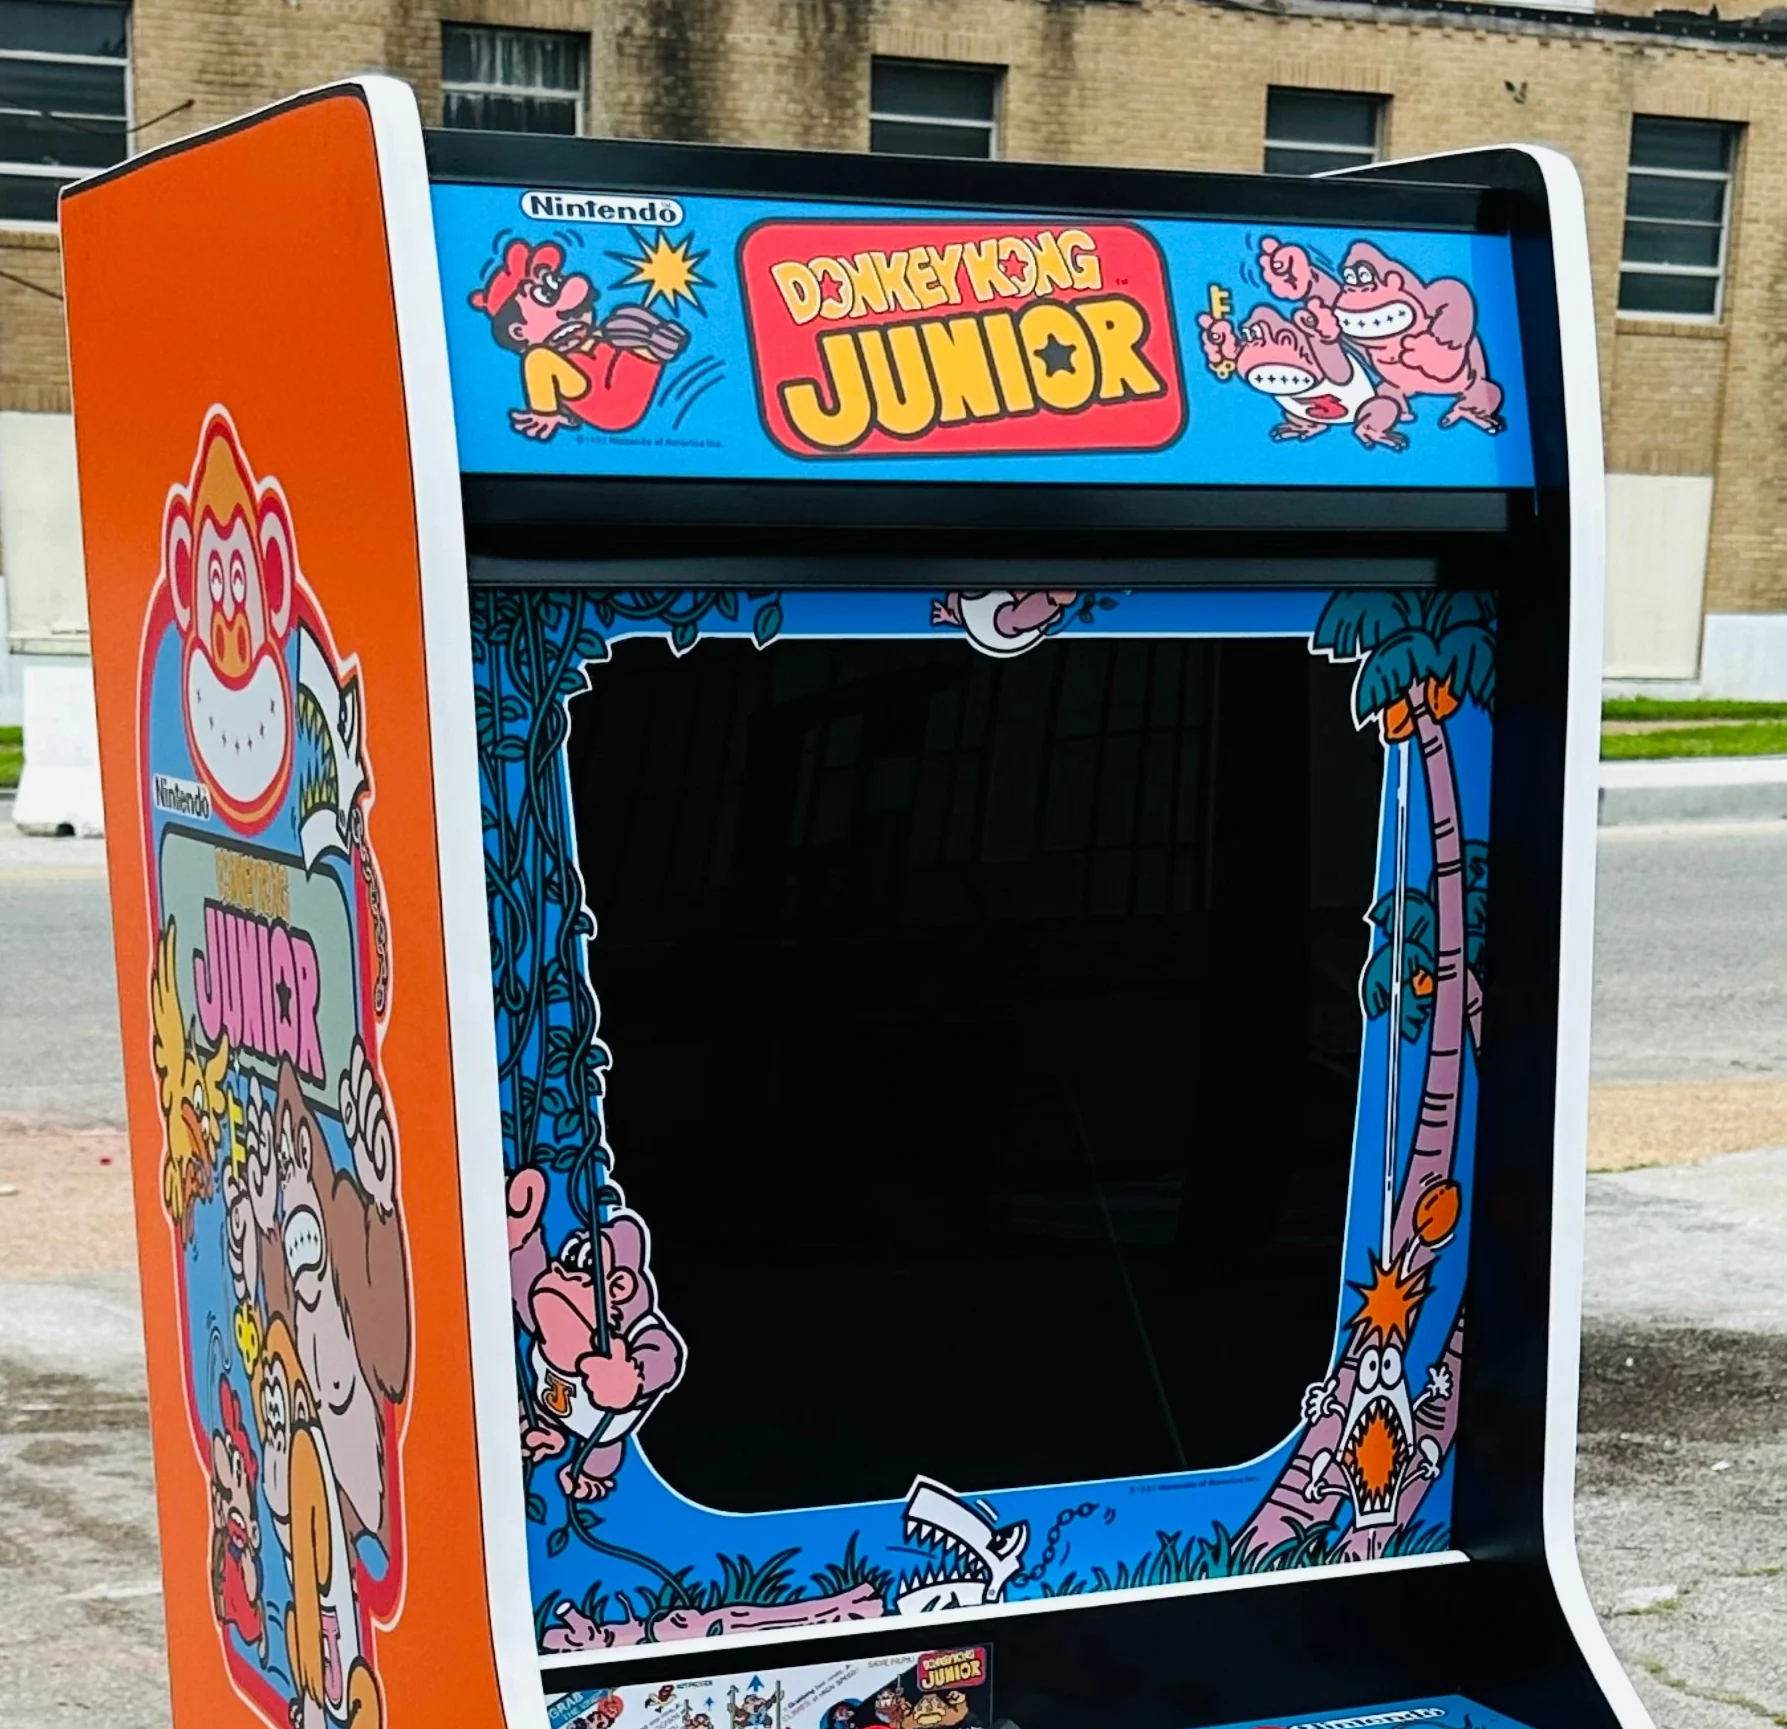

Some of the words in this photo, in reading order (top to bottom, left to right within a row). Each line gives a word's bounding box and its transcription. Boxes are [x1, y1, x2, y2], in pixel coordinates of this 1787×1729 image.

[531, 195, 677, 223] Nintendo
[771, 244, 963, 325] DONKEY
[961, 229, 1102, 302] KONG
[781, 296, 1164, 449] JUNIOR
[155, 776, 210, 819] Nintendo
[193, 898, 326, 1091] JUNIOR
[920, 1660, 983, 1689] JUNIOR
[549, 1692, 583, 1719] GRAB
